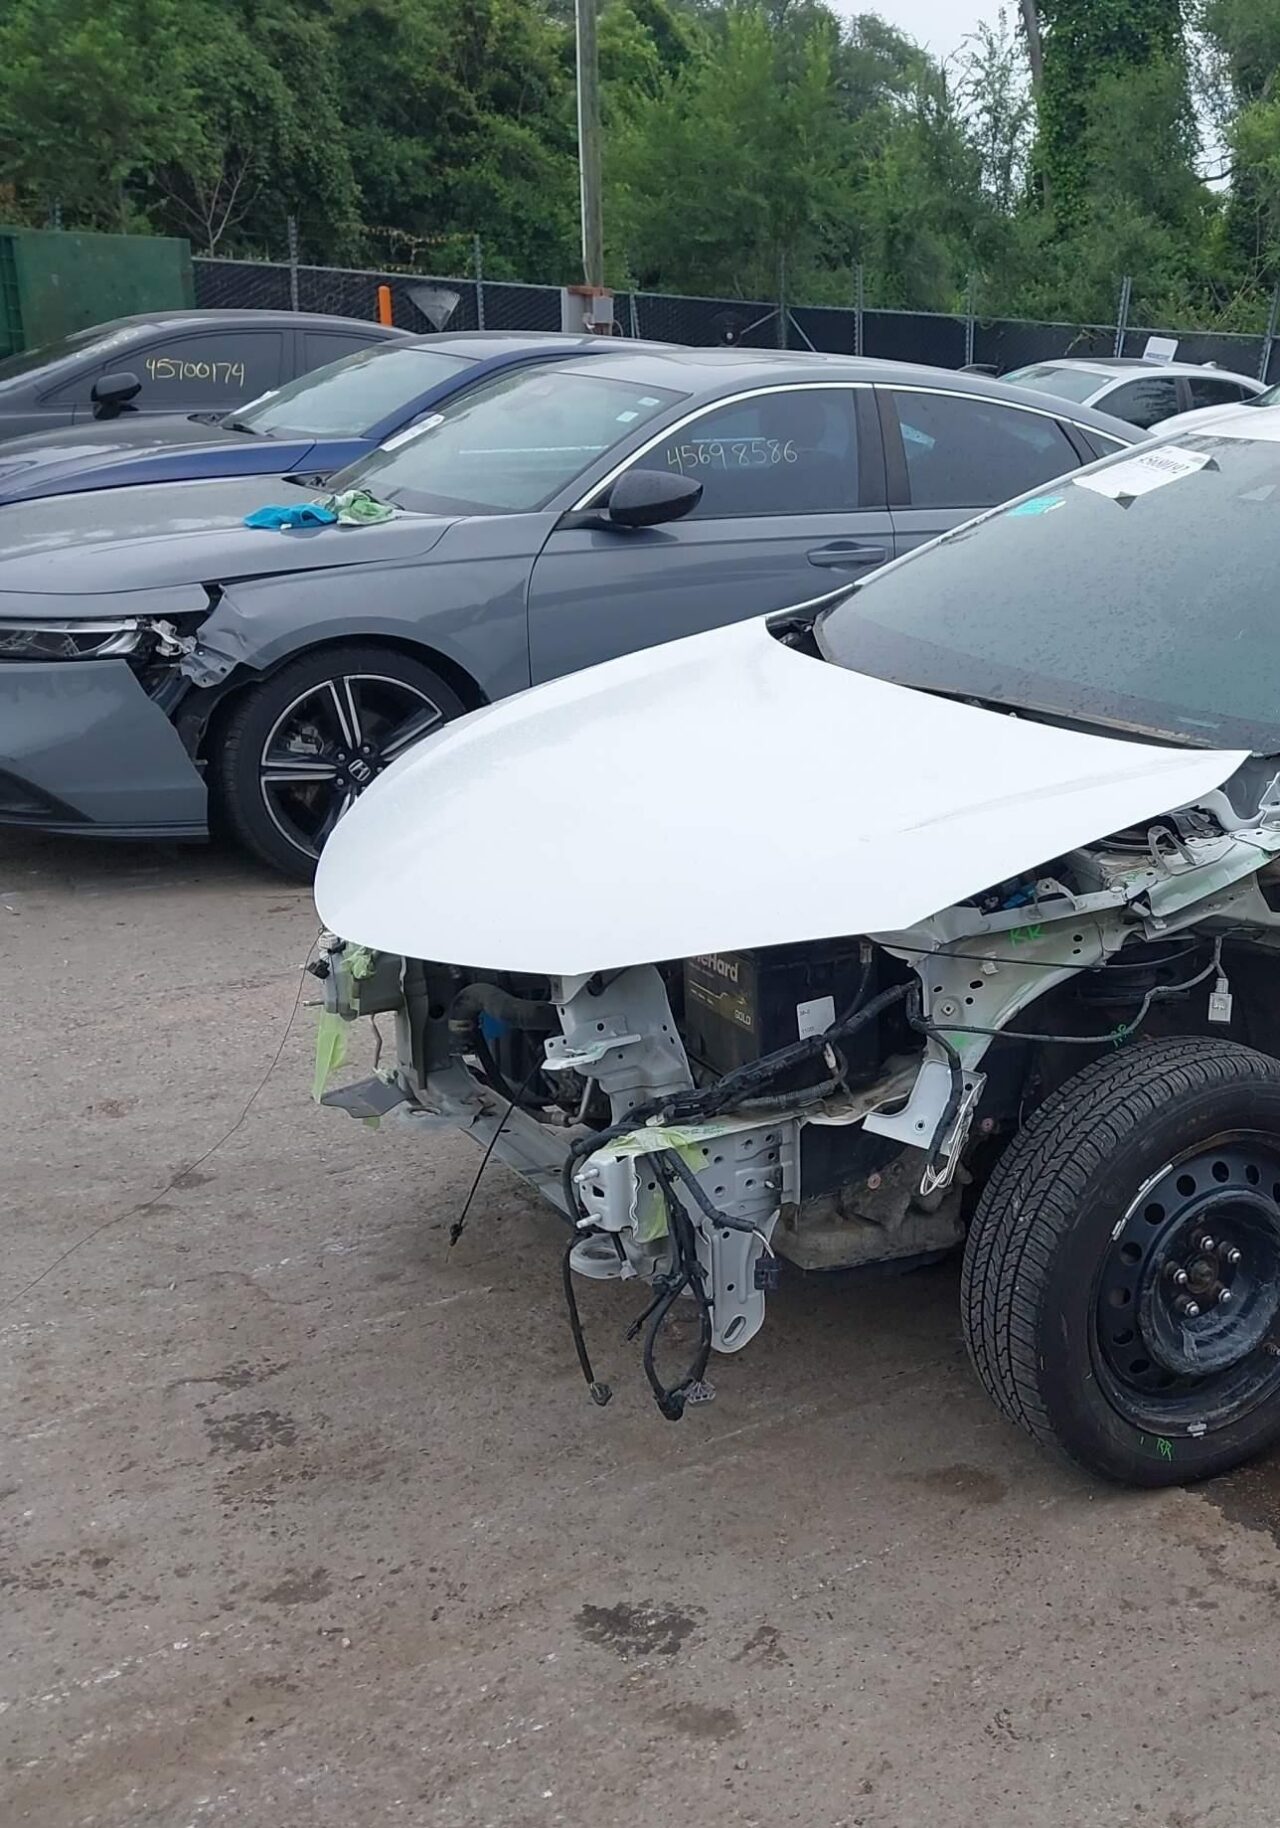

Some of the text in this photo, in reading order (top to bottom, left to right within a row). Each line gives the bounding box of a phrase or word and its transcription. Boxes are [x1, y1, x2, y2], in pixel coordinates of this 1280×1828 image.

[146, 358, 244, 387] 45700174
[667, 439, 798, 475] 45698586
[698, 953, 739, 982] eHard
